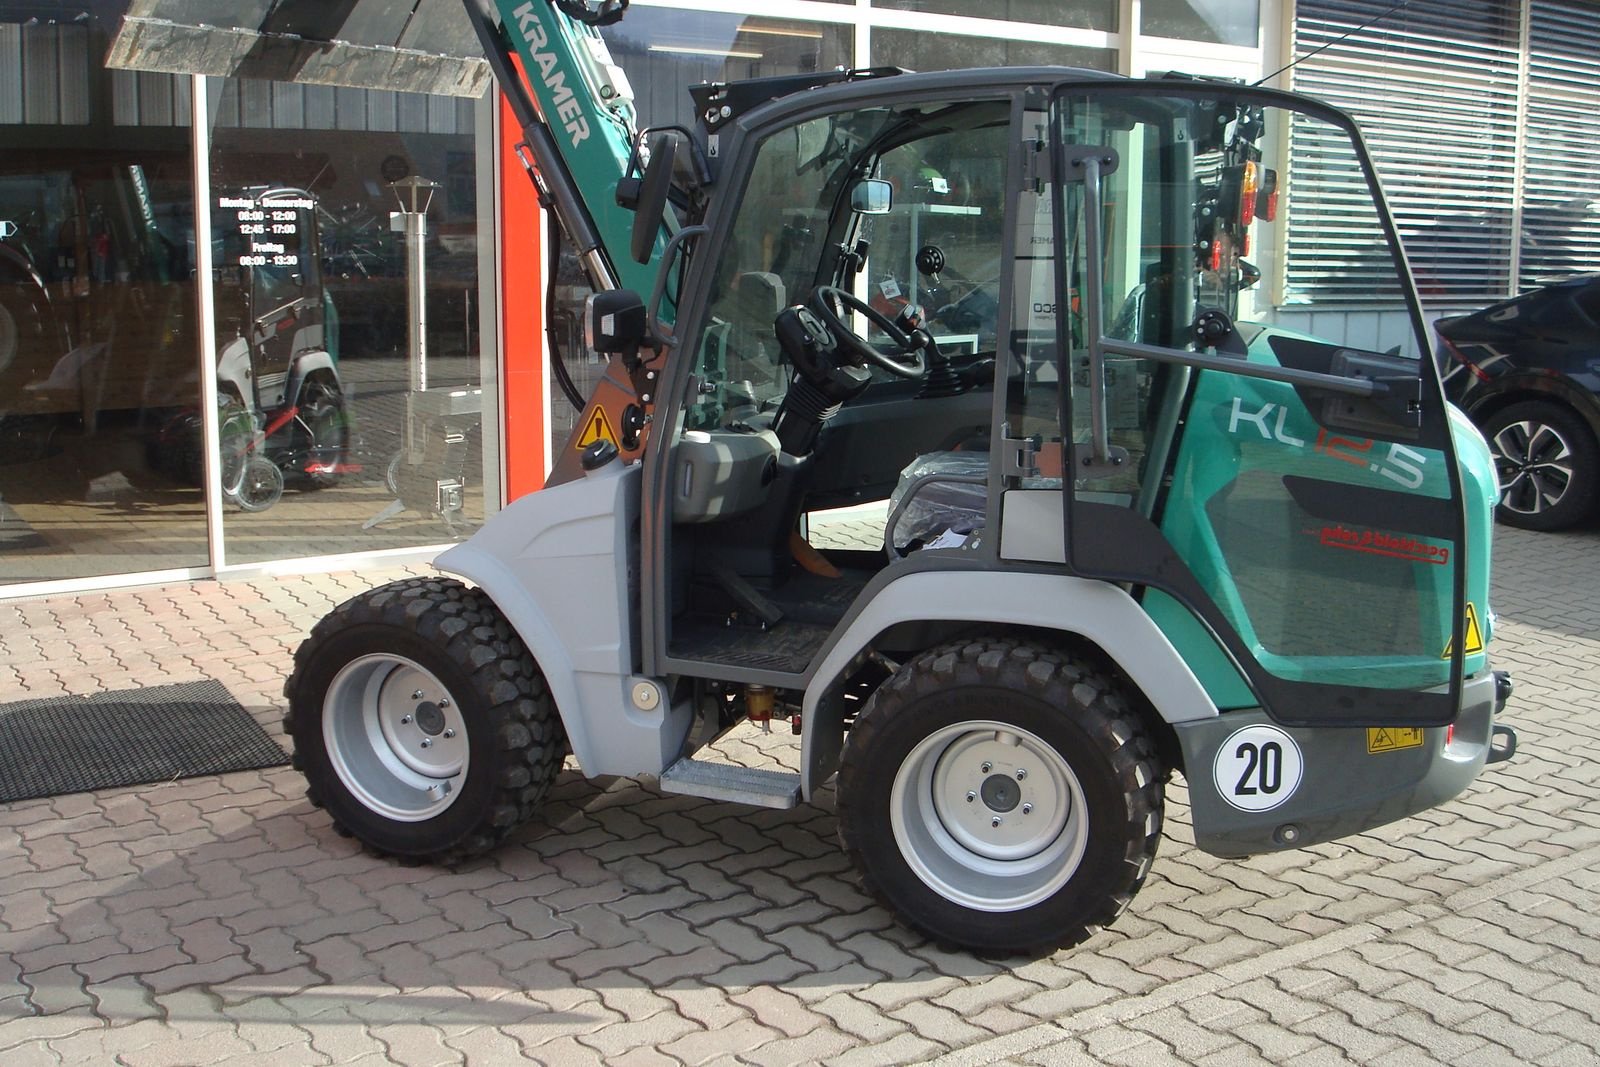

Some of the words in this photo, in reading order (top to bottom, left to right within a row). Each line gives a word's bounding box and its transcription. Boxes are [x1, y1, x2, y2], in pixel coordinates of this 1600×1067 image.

[512, 1, 590, 149] KRAMER
[219, 198, 255, 209] Montag
[262, 198, 314, 209] Donnerstag
[238, 211, 264, 220] 08:00
[271, 211, 296, 220] 12:00
[240, 224, 264, 234] 12:45
[271, 224, 296, 234] 17:00
[252, 243, 285, 254] Freitag
[240, 255, 266, 265] 08:00
[272, 255, 298, 265] 13:30
[1234, 741, 1283, 796] 20
